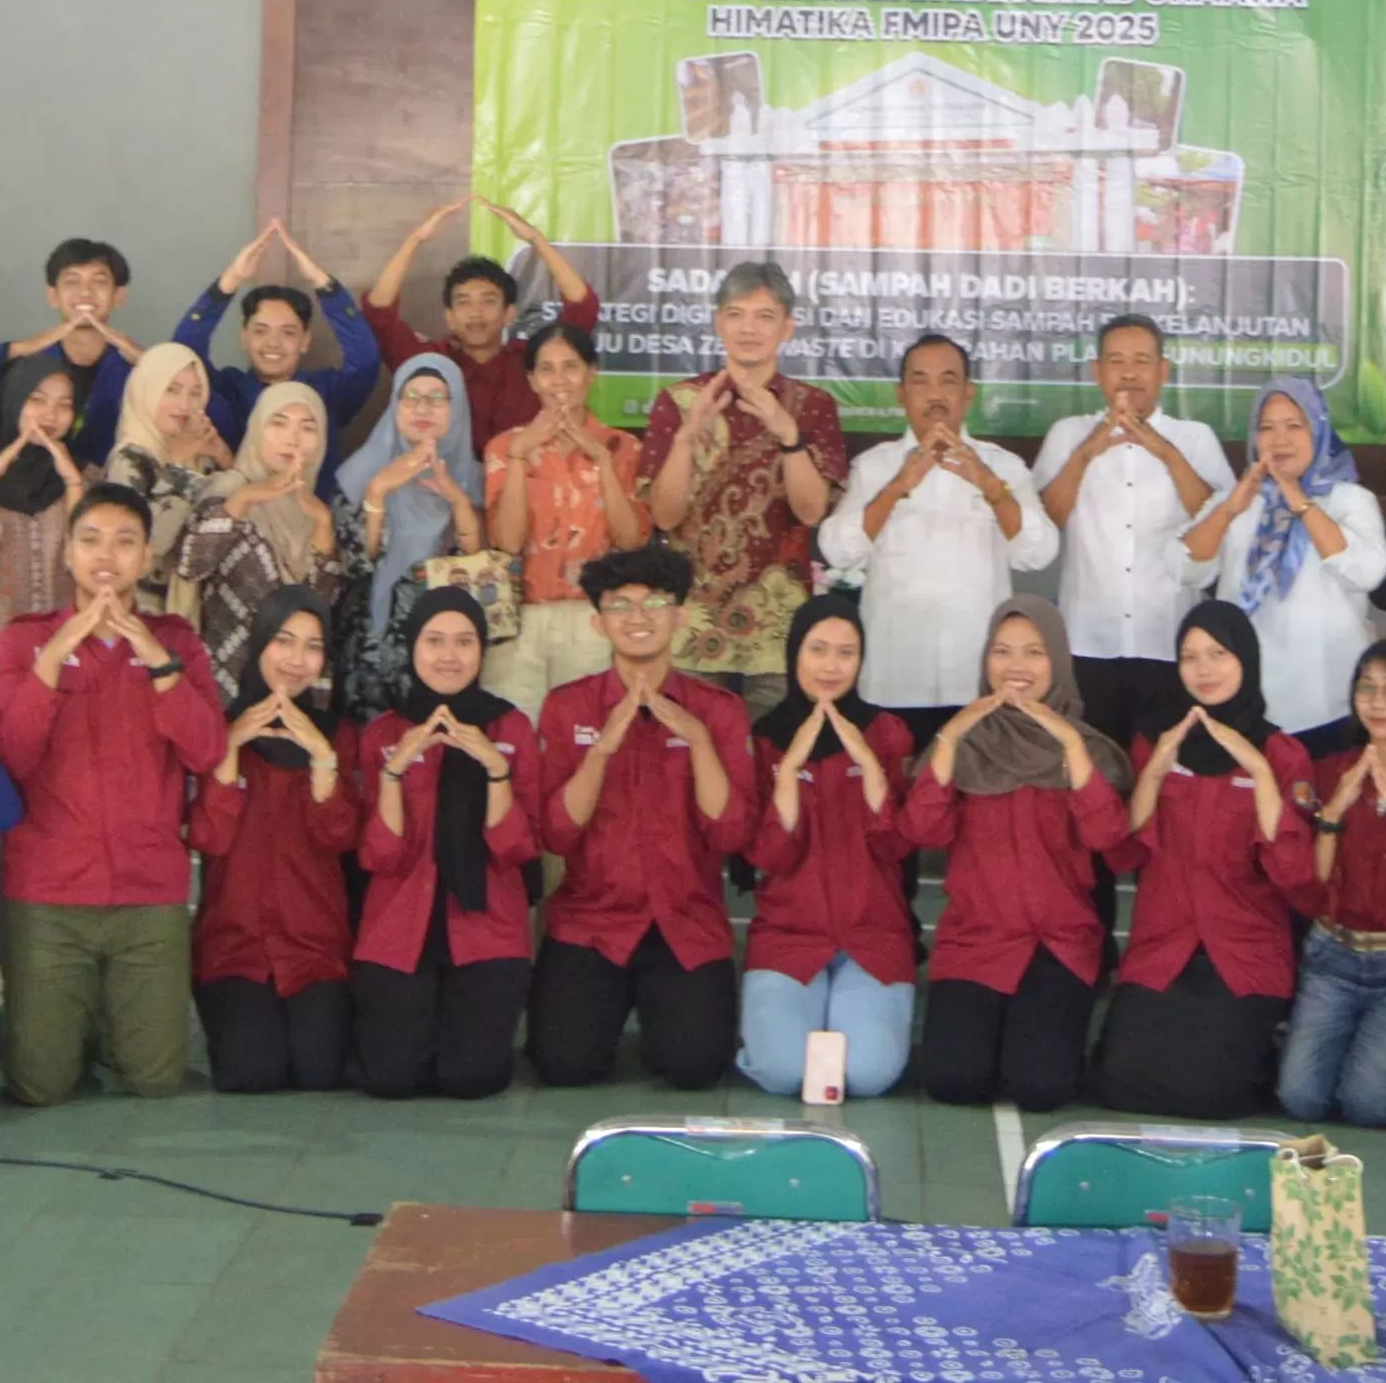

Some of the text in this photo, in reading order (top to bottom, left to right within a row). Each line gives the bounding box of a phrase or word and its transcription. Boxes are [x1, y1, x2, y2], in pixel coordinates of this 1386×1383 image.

[709, 5, 1158, 44] HIMATIKA FMIPA UNY 2025
[808, 270, 952, 304] (SAMPAH
[960, 273, 1038, 300] DADI
[1044, 276, 1196, 311] BERKAH):
[819, 307, 871, 329] DAN
[879, 308, 984, 331] EDUKASI
[989, 310, 1095, 332] SAMPAH
[628, 334, 695, 355] DESA
[860, 337, 886, 359] DI
